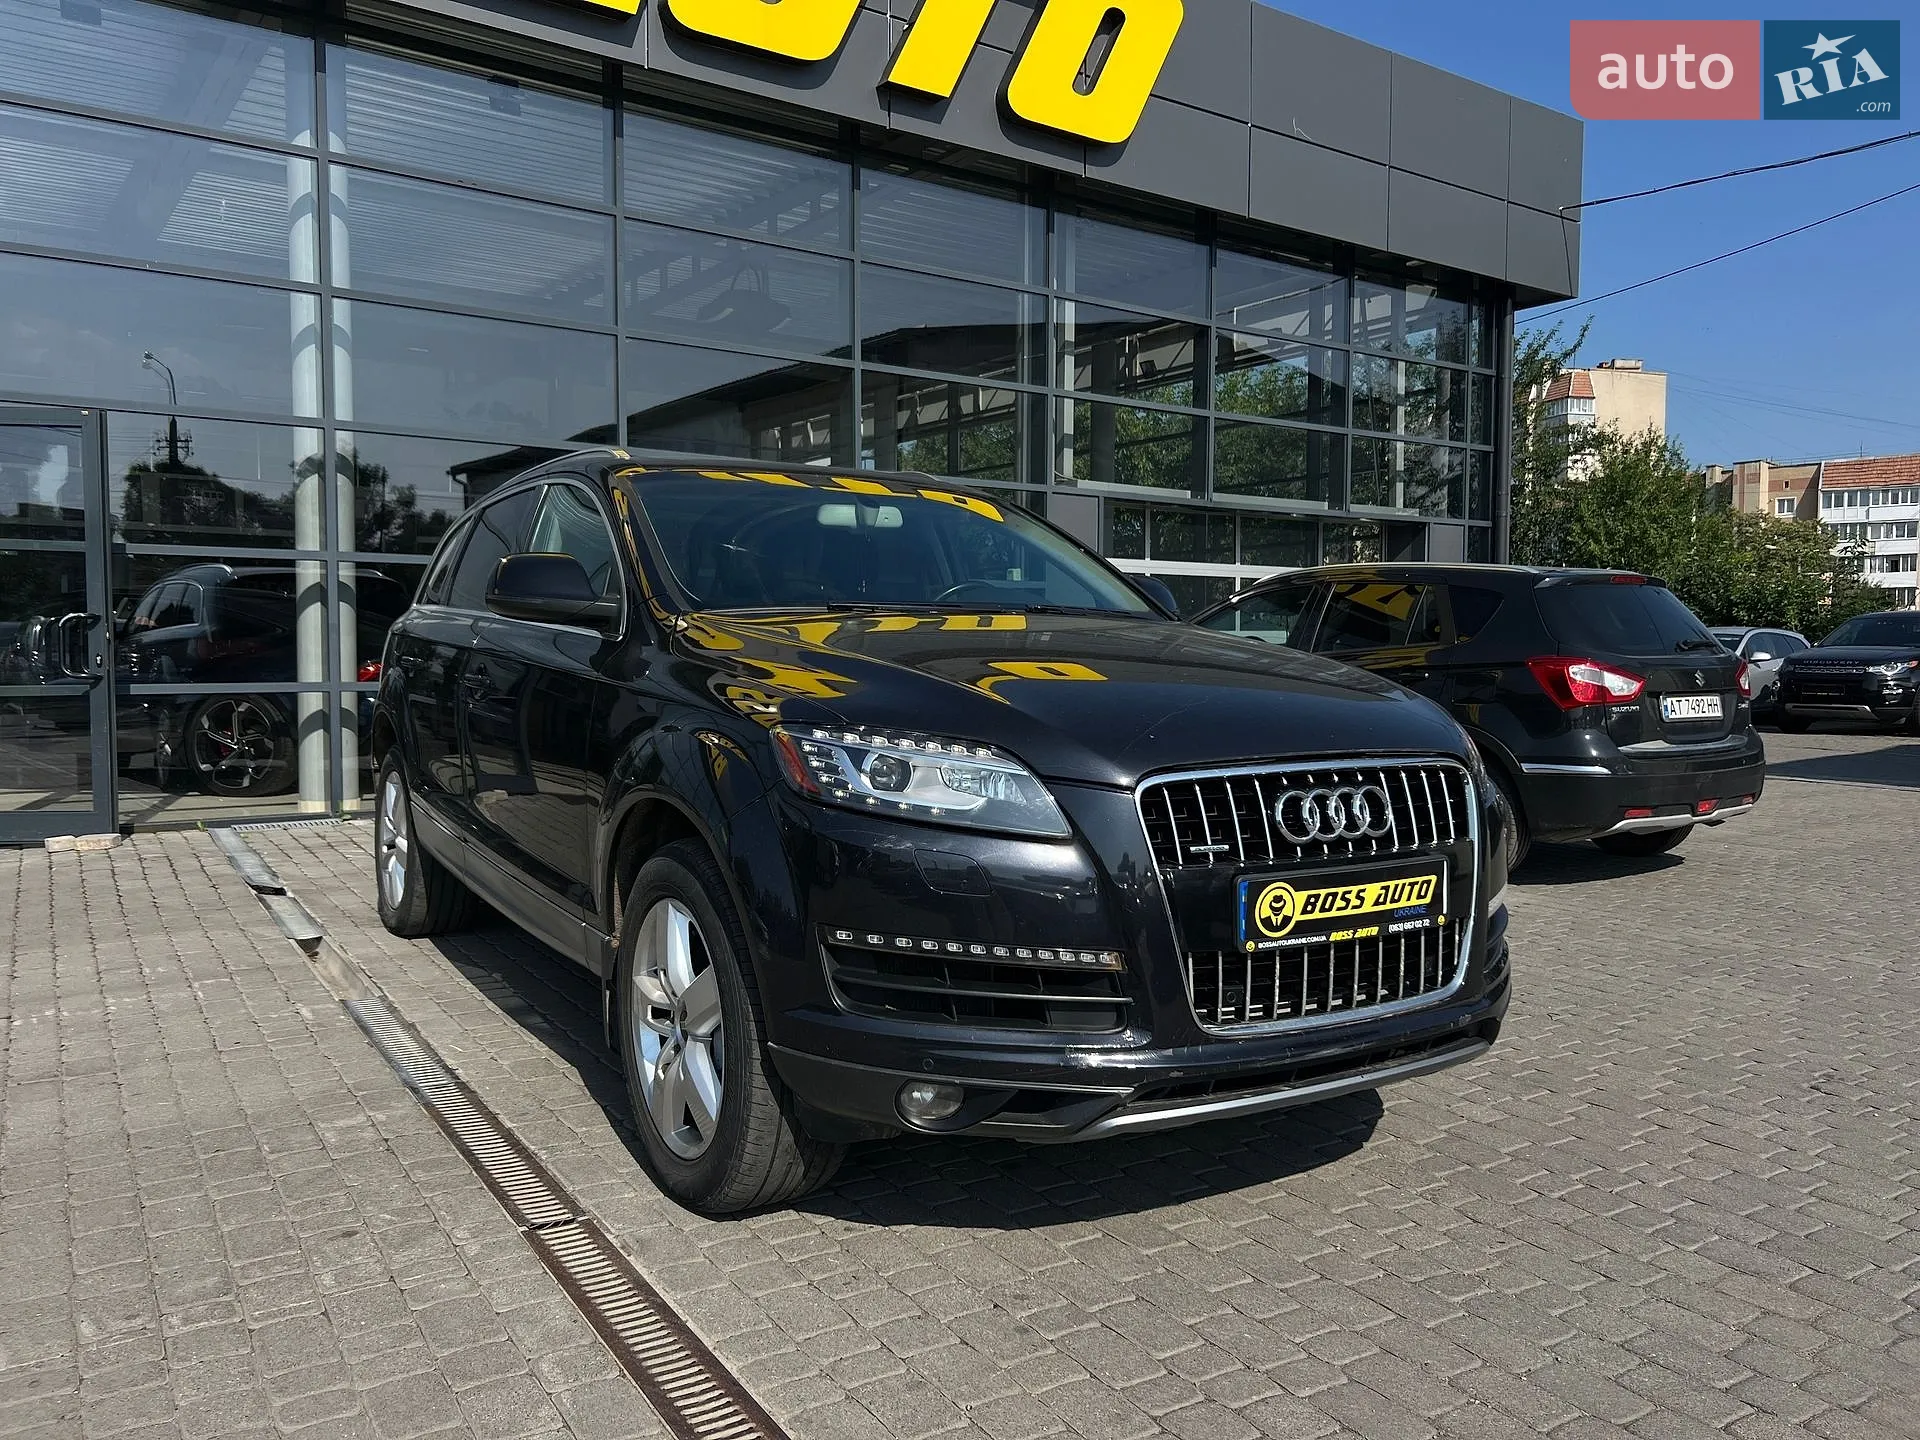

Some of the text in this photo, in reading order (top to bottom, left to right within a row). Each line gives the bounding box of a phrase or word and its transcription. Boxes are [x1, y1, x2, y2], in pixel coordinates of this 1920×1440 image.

[1670, 699, 1682, 715] AT
[1685, 698, 1706, 715] 7492
[1707, 698, 1720, 713] HH
[1300, 879, 1433, 915] BOSS AUTO
[1393, 905, 1428, 918] UKRAINE
[1329, 926, 1379, 941] BOSS AUTO
